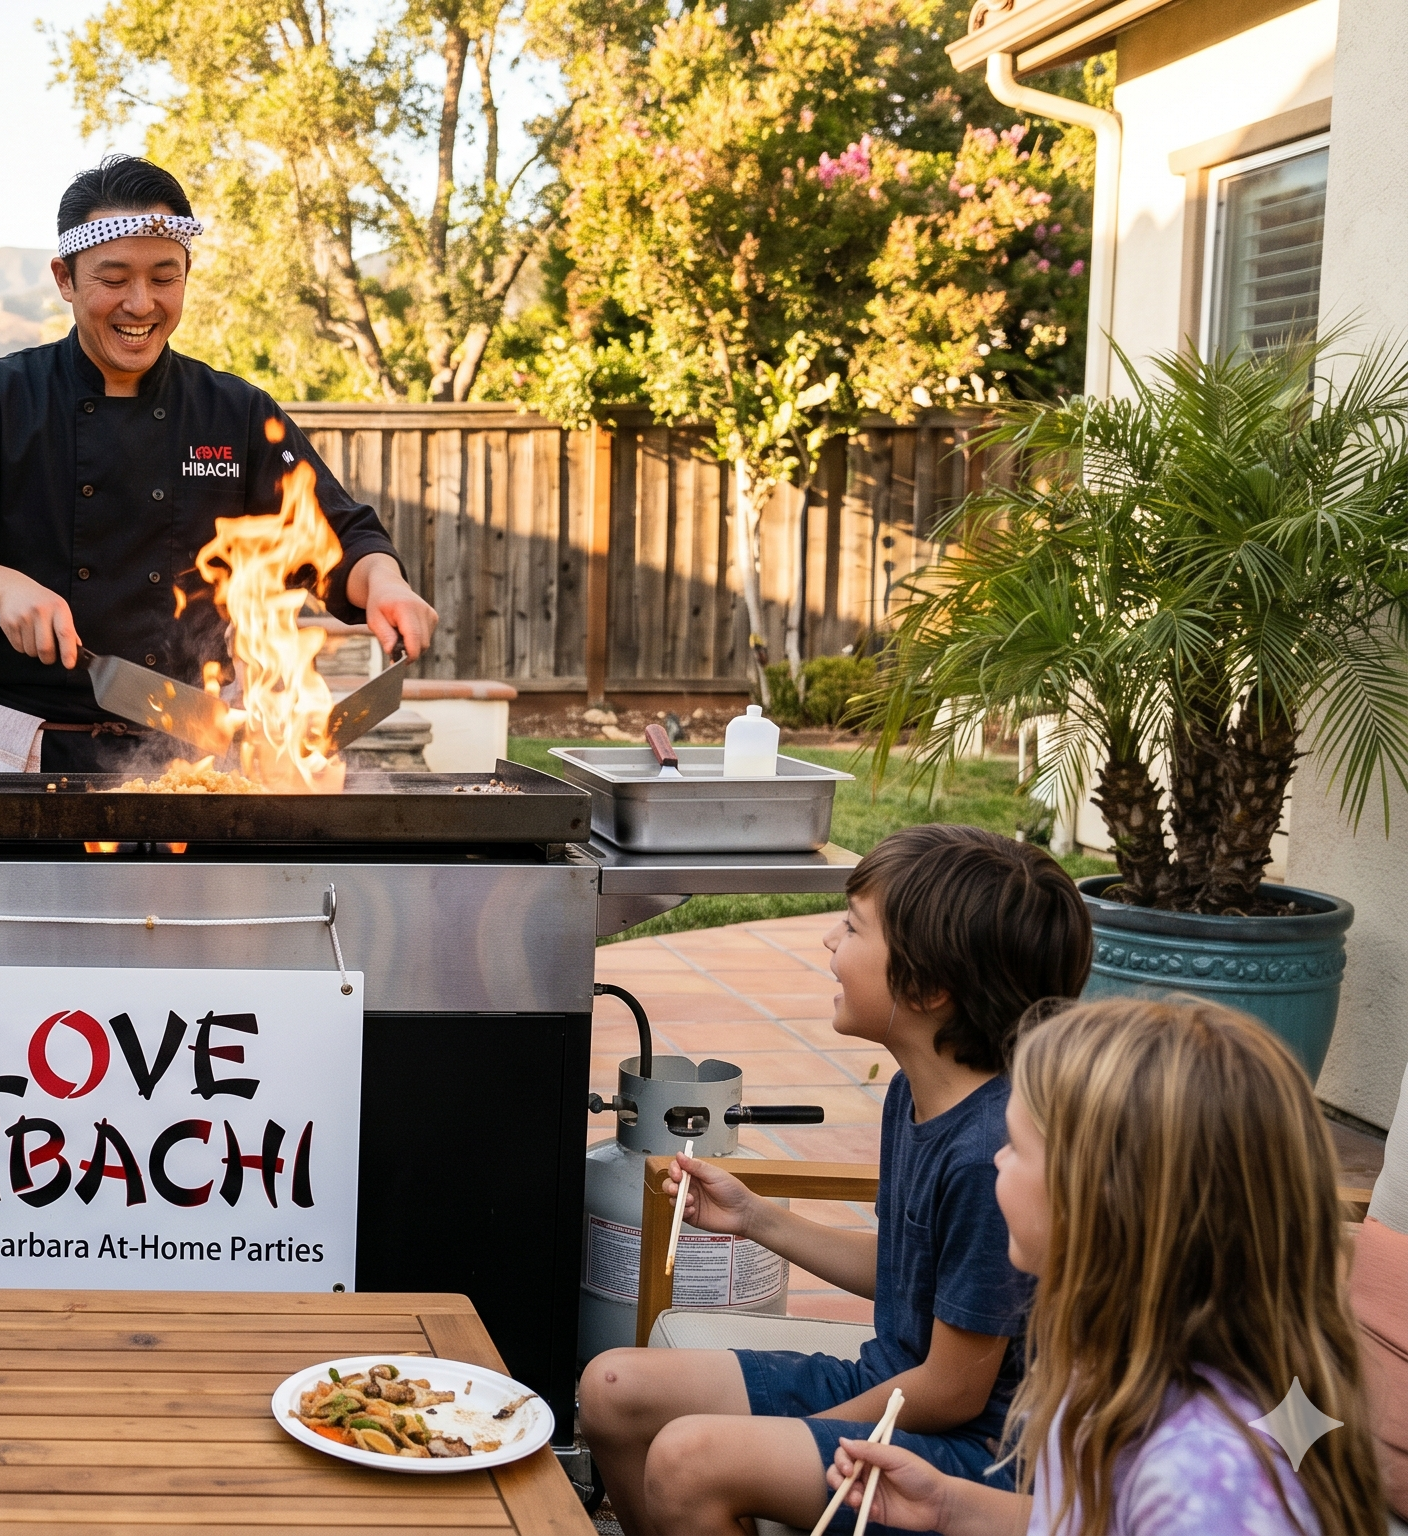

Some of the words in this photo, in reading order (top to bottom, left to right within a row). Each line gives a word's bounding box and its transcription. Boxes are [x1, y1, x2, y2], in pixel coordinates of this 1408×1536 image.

[181, 461, 240, 478] HIBACHI
[97, 1233, 222, 1261] At-Home
[230, 1236, 324, 1263] Parties
